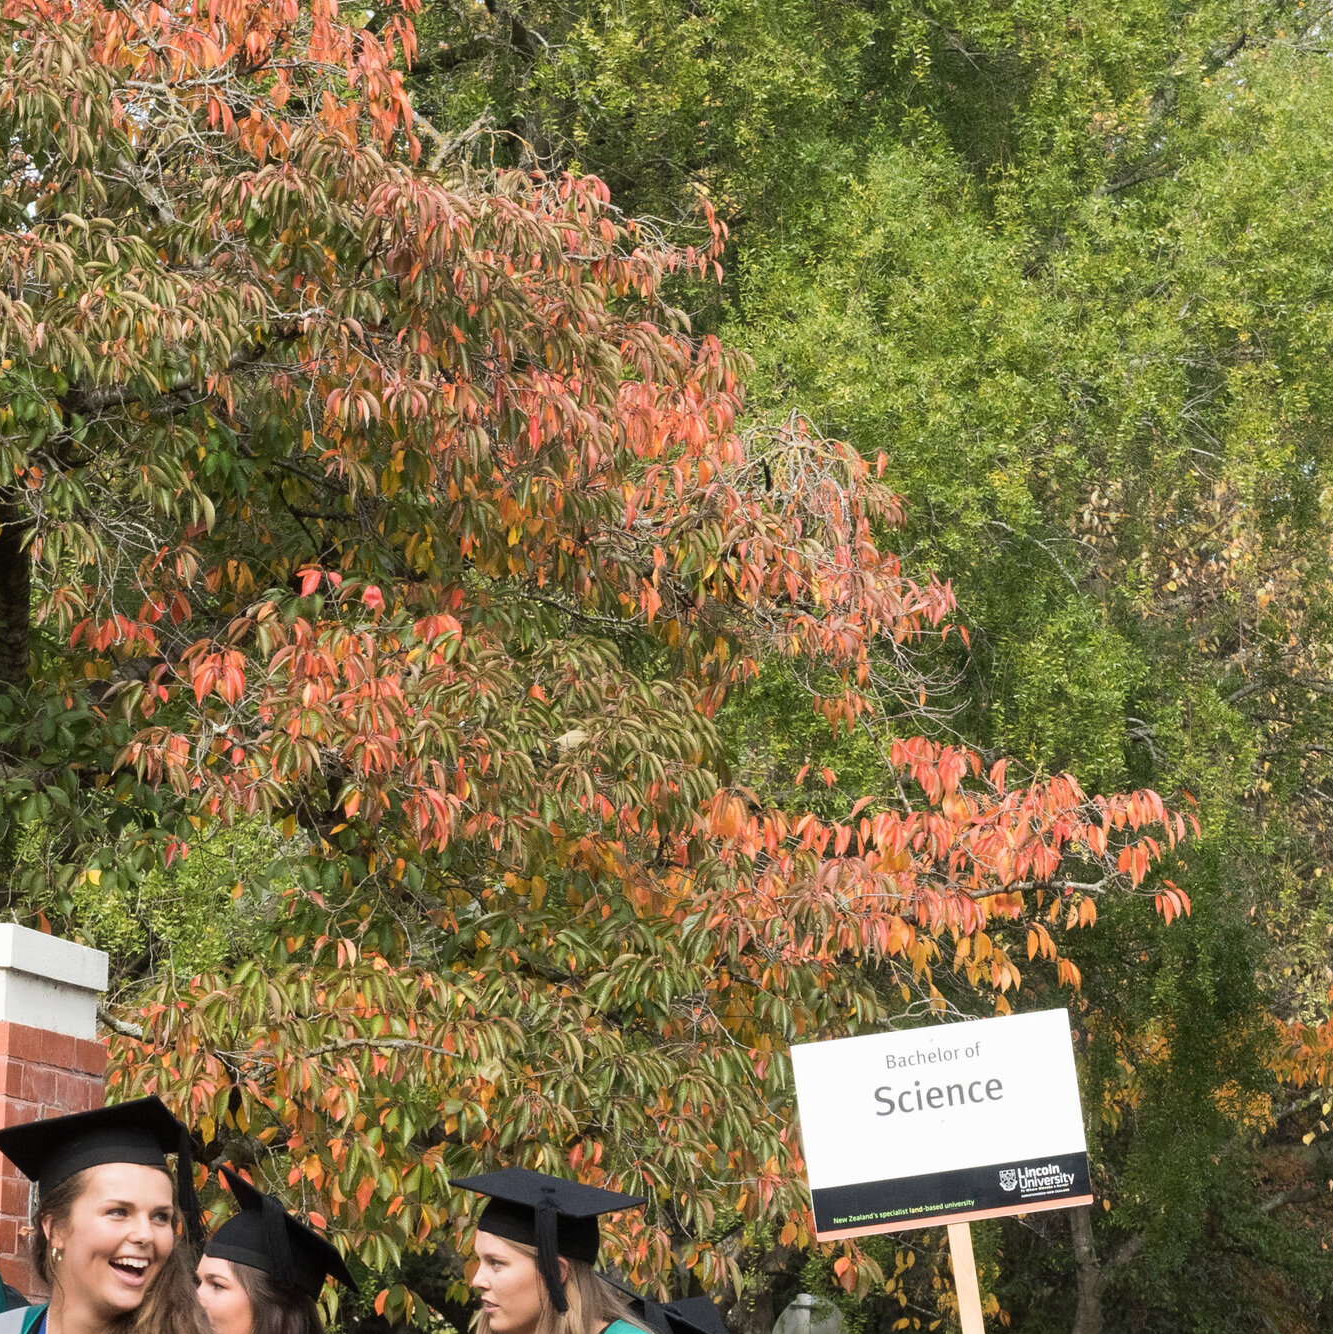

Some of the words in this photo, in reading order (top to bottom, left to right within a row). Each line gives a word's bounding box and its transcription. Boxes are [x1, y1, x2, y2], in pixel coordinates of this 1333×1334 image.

[885, 1046, 961, 1070] Bachelor
[965, 1041, 982, 1058] of
[873, 1077, 1004, 1117] Science
[1017, 1163, 1060, 1179] Lincoln
[1018, 1172, 1075, 1189] University
[833, 1217, 848, 1225] New
[848, 1212, 879, 1223] Zealand's
[879, 1208, 909, 1219] specialist
[909, 1204, 944, 1214] land-based
[944, 1199, 975, 1210] university
